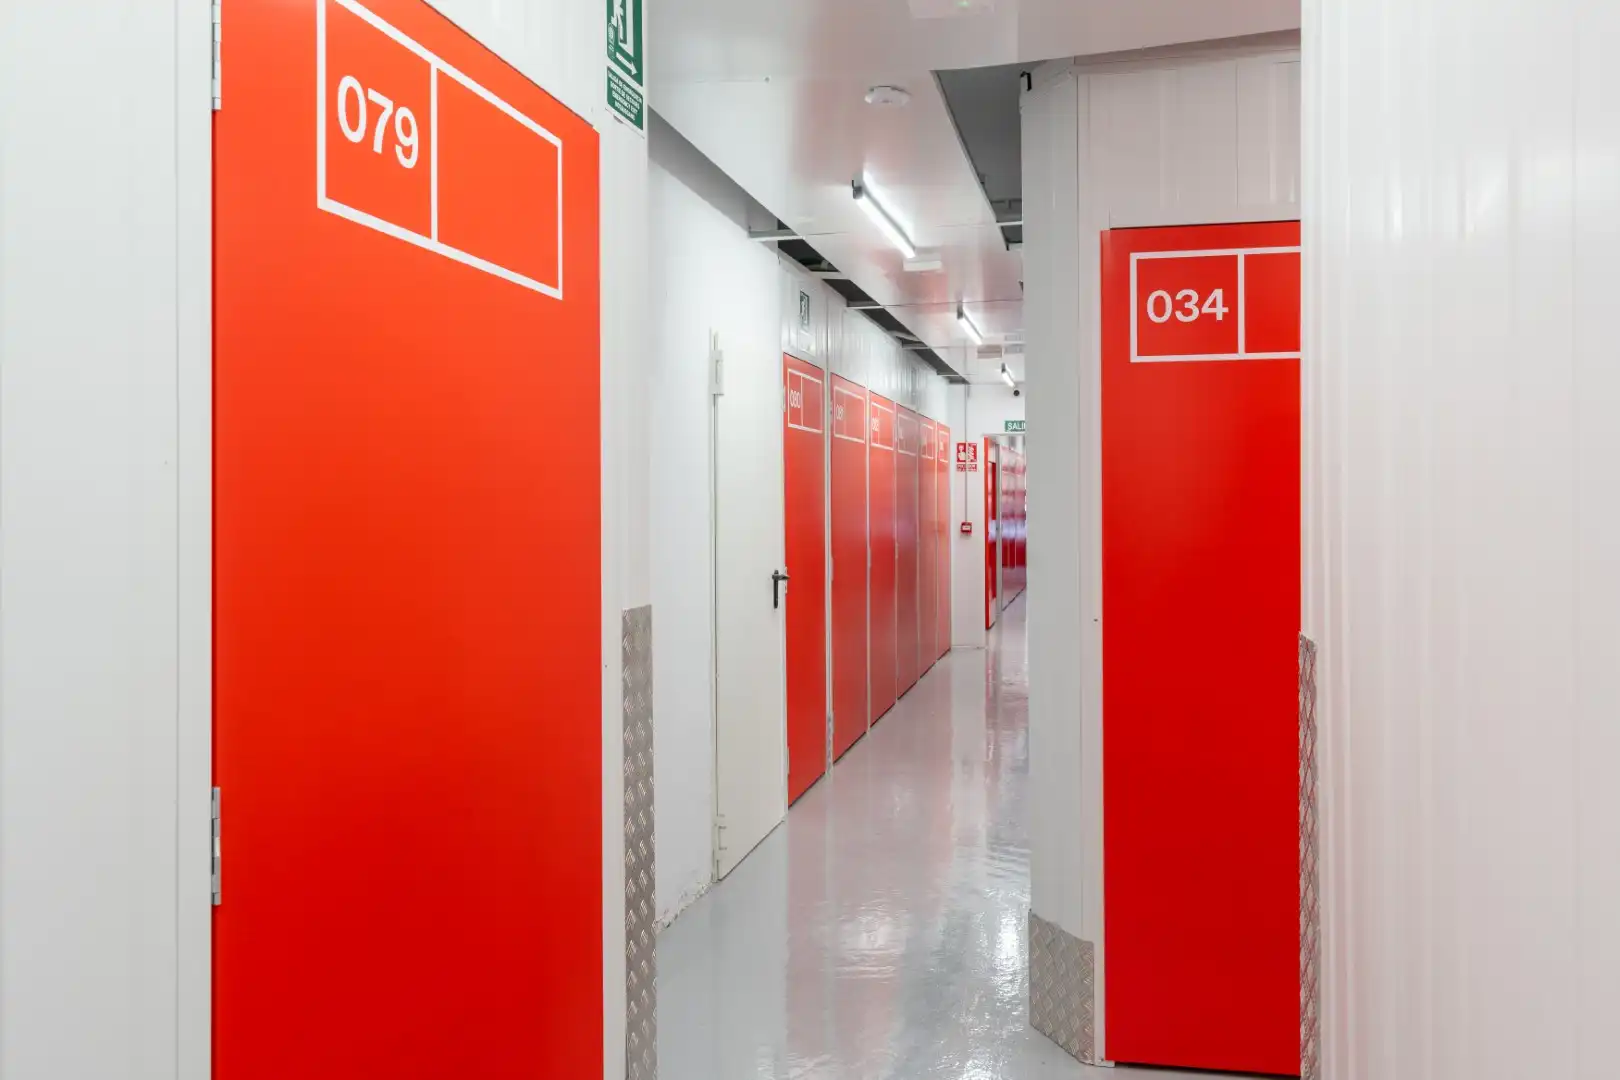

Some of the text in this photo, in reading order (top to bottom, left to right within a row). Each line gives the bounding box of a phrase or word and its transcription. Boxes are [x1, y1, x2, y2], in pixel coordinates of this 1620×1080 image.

[338, 76, 418, 168] 079
[1148, 289, 1228, 322] 034
[1007, 422, 1026, 430] SALI
